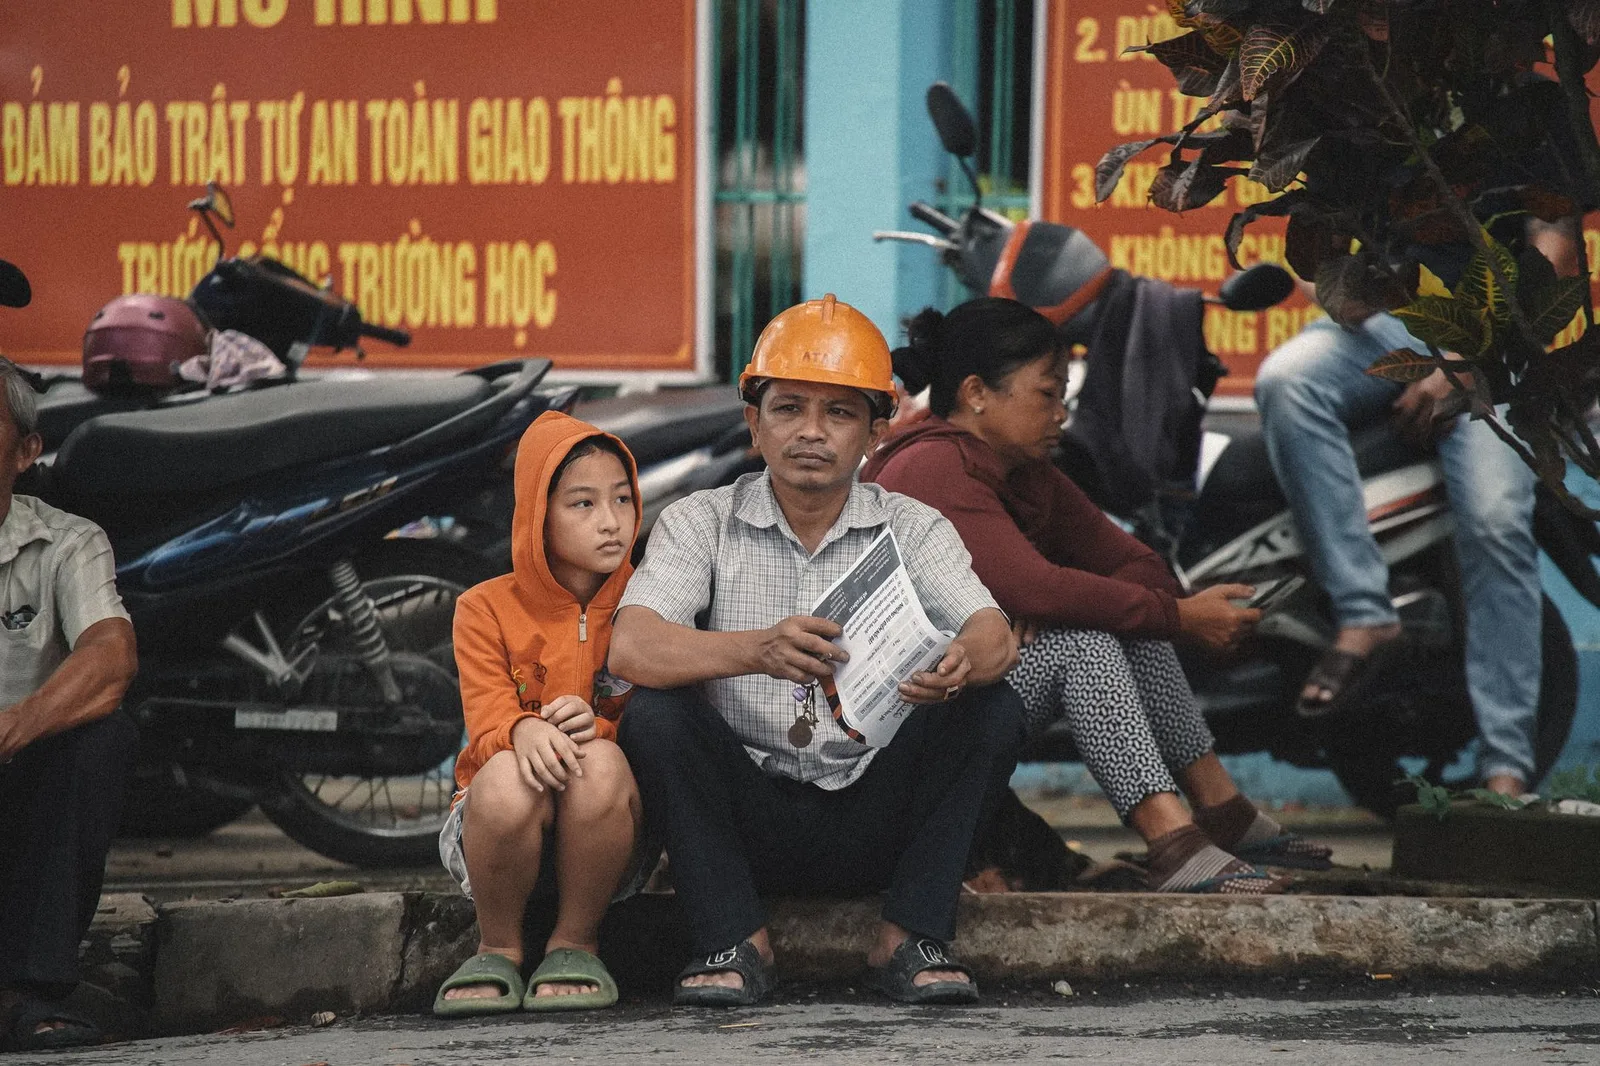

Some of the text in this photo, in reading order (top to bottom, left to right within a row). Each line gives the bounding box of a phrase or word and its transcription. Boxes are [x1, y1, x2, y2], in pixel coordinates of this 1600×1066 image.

[88, 64, 157, 187] BẢO
[256, 89, 304, 205] TỰ
[307, 99, 358, 186] AN
[366, 79, 459, 185] TOÀN
[467, 96, 550, 185] GIAO
[558, 76, 677, 184] THÔNG
[337, 217, 478, 328] TRƯỜNG
[485, 240, 557, 348] HỌC
[1111, 226, 1225, 280] KHÔNG
